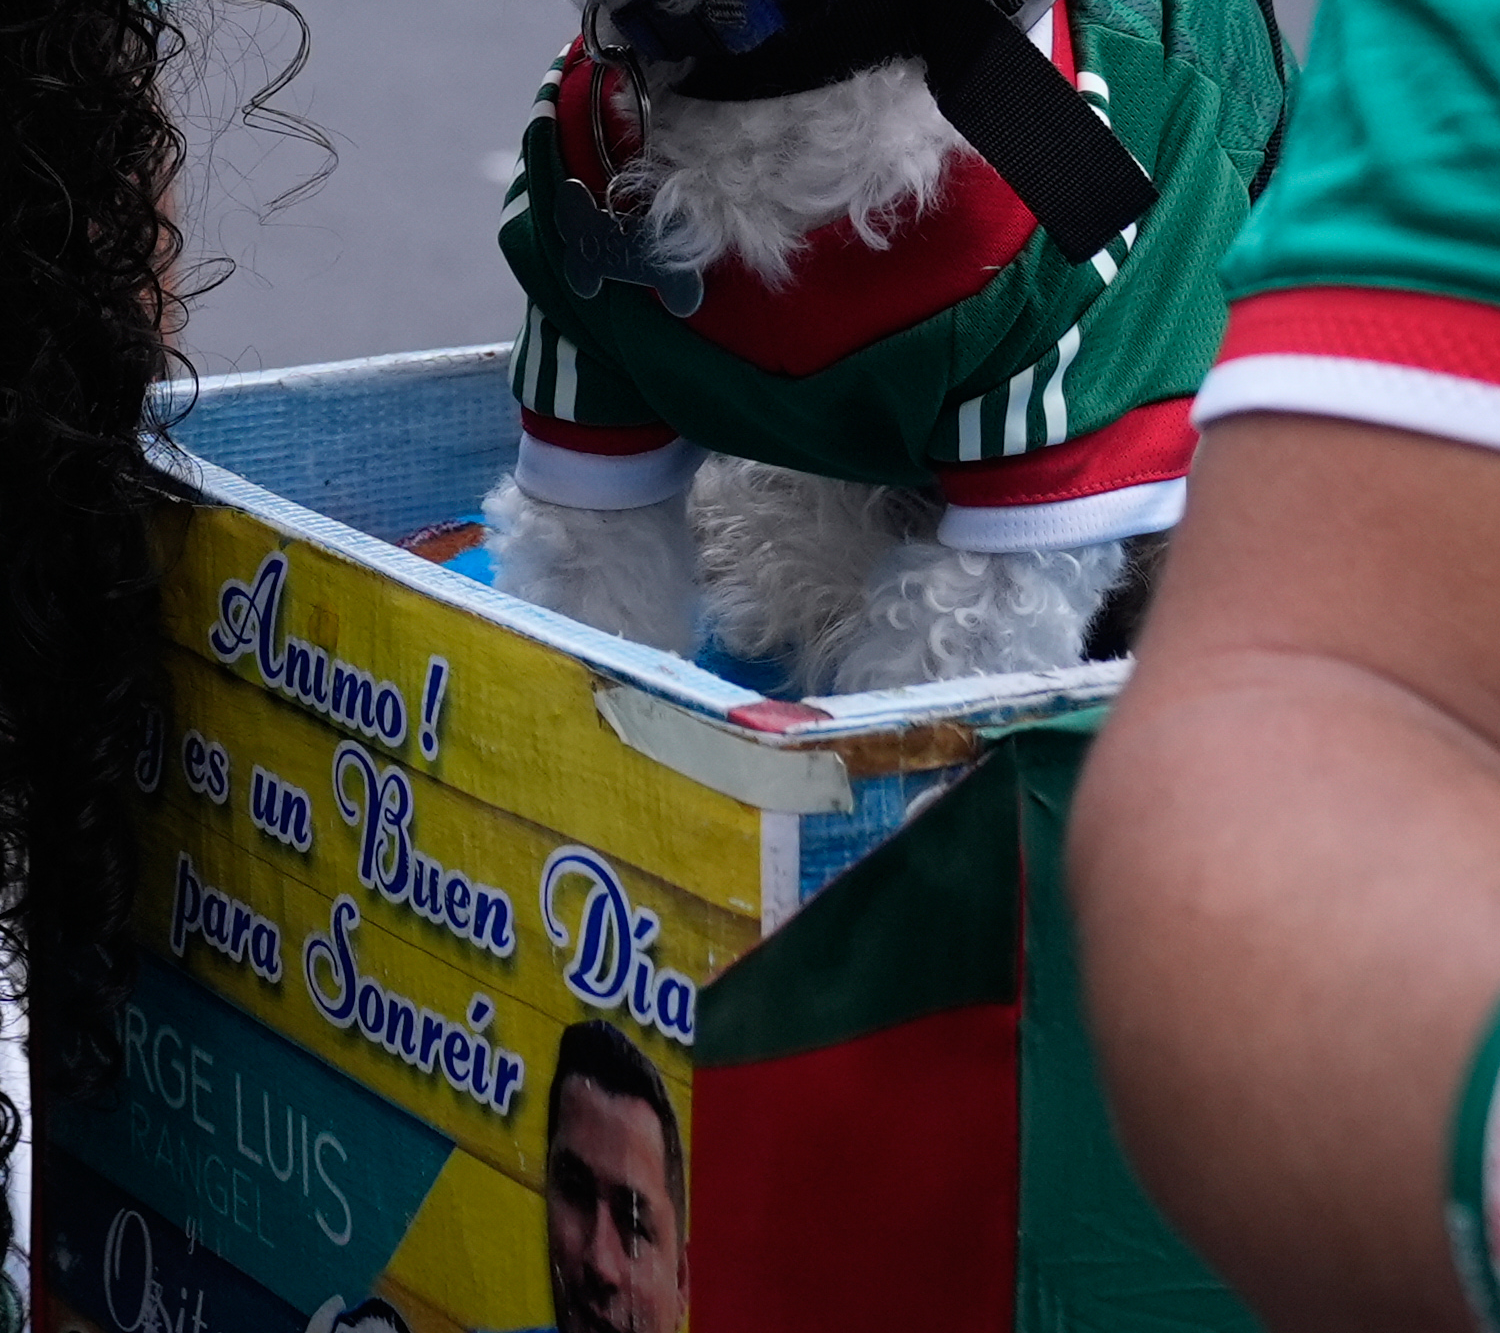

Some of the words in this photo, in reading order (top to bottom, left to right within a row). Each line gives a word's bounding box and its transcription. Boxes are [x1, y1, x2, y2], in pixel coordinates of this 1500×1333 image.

[171, 853, 281, 980] para
[305, 897, 522, 1113] Sonreír
[182, 731, 228, 803] es
[251, 765, 311, 851] un
[334, 743, 512, 954] Buen
[542, 847, 695, 1042] Día
[114, 1002, 216, 1135] RGE
[234, 1072, 353, 1247] LUIS
[129, 1100, 275, 1249] RANGEL
[102, 1207, 222, 1333] Osit
